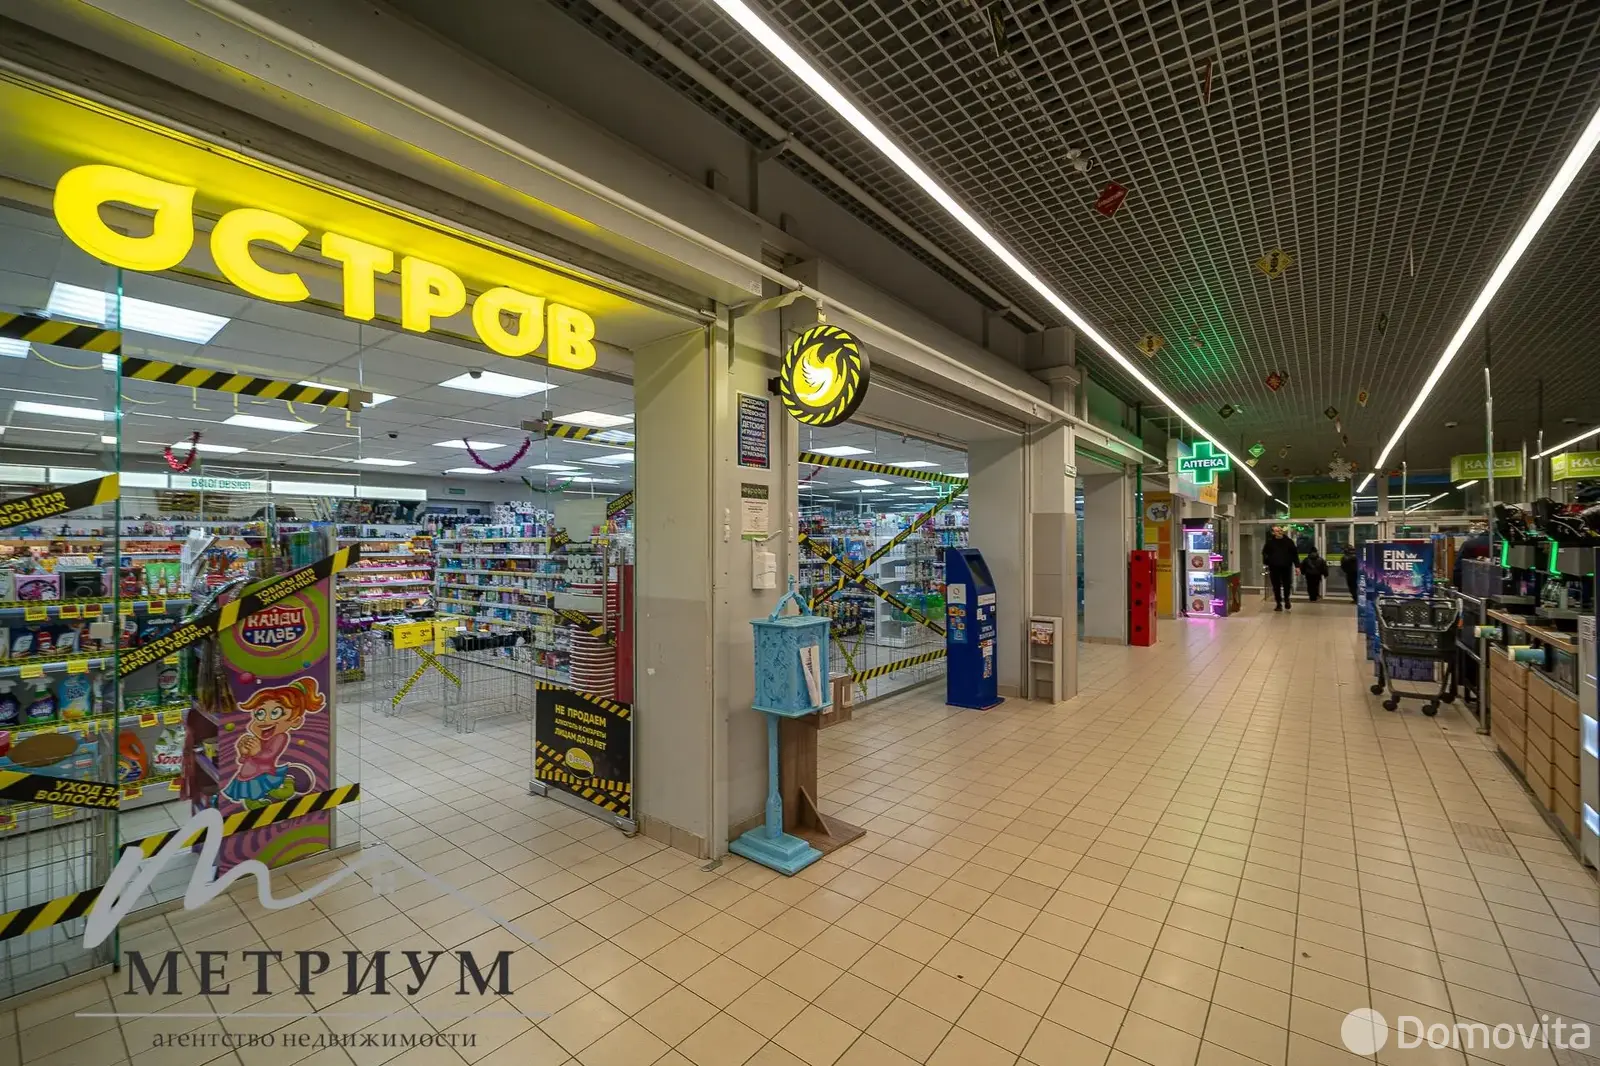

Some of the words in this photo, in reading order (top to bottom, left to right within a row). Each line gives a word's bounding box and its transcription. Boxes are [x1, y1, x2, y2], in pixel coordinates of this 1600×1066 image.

[53, 164, 597, 370] ОСТРОВ
[1183, 459, 1224, 469] АПТЕКА
[30, 491, 66, 508] ДЛЯ
[1383, 550, 1405, 559] FIN
[1383, 562, 1413, 571] LINE
[257, 576, 296, 599] ТОВАРЫ
[293, 567, 315, 582] ДЛЯ
[262, 573, 317, 605] ЖИВОТНЫХ
[247, 609, 301, 628] КАНДИ
[155, 647, 167, 657] И
[166, 625, 213, 653] УБОРКИ
[172, 624, 197, 640] ДЛЯ
[555, 704, 565, 715] НЕ
[567, 707, 607, 727] ПРОДАЕМ
[554, 727, 576, 740] ЛИЦАМ
[576, 734, 586, 744] ДО
[586, 737, 593, 746] 18
[594, 740, 607, 750] ЛЕТ
[55, 780, 100, 796] УХОД
